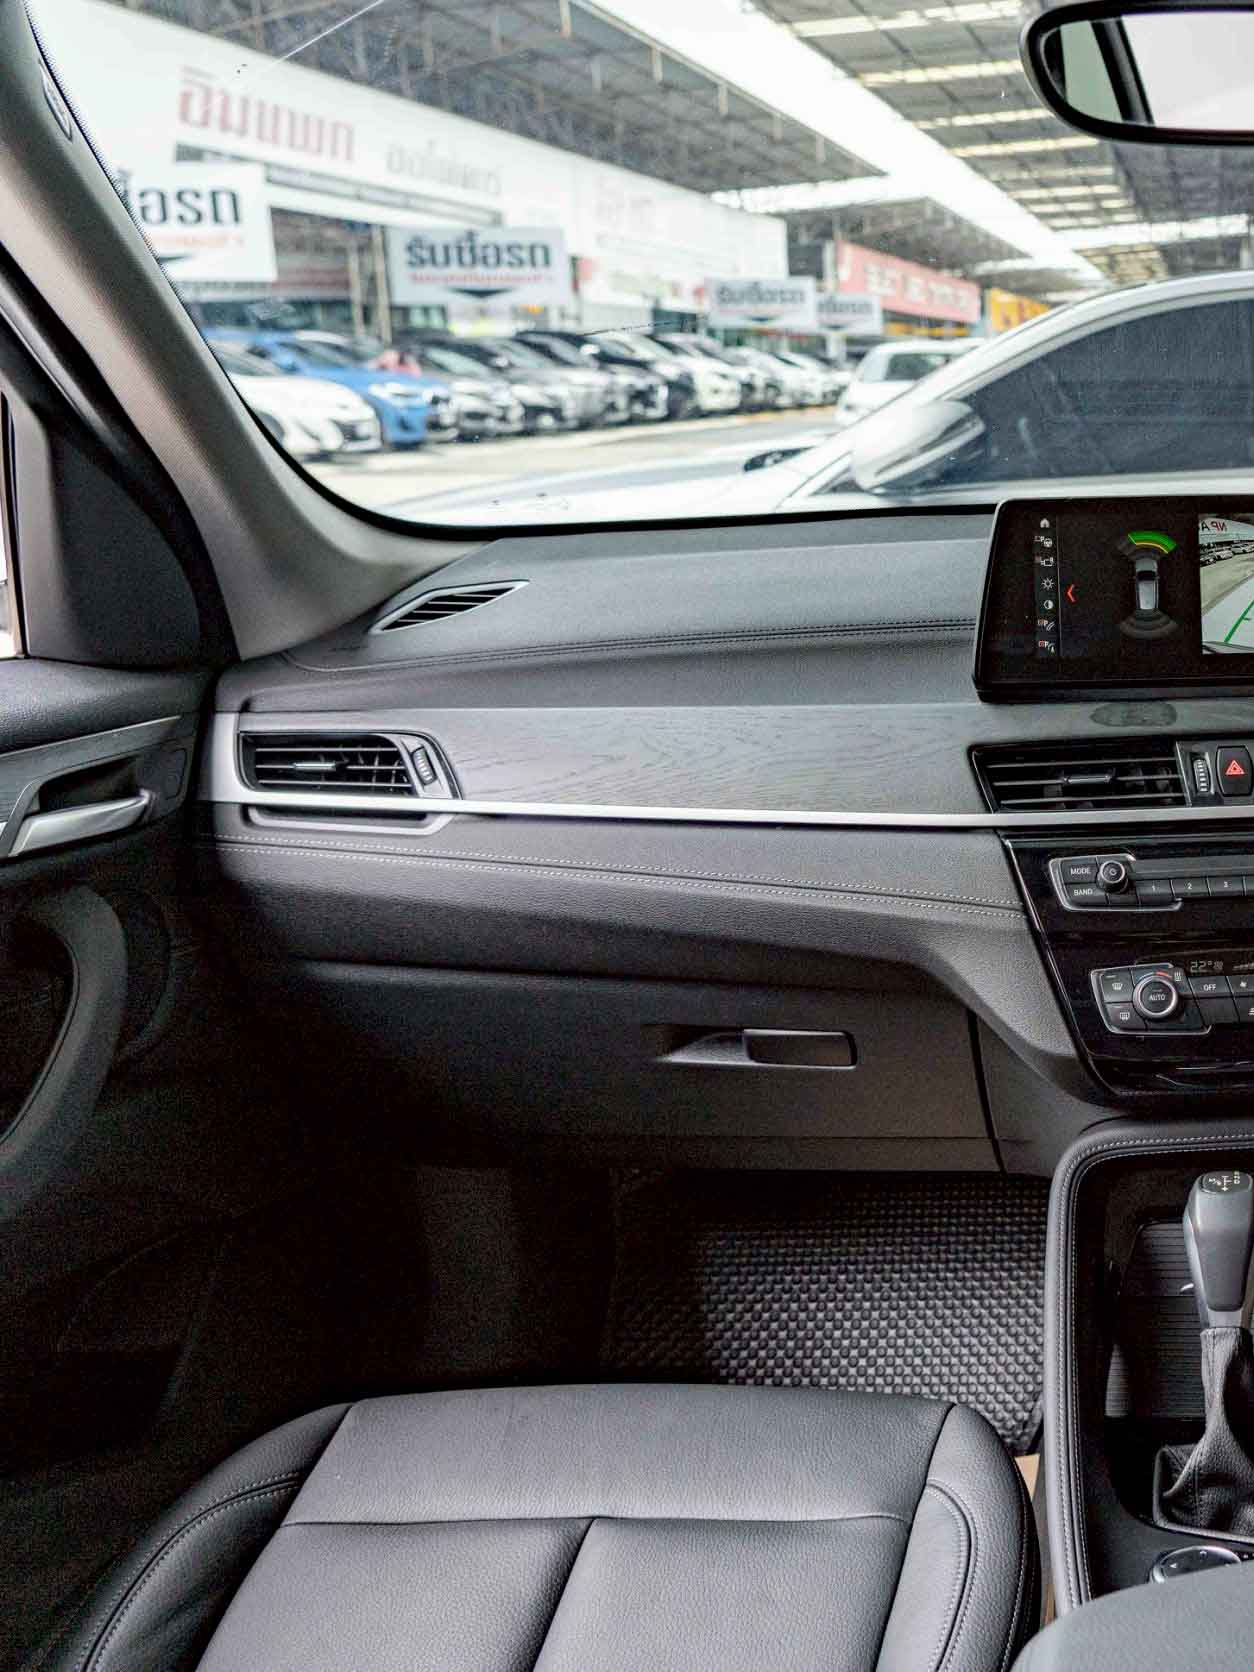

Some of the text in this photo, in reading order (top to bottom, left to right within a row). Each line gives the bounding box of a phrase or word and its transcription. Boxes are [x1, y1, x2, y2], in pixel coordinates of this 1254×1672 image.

[1070, 867, 1092, 875] MODE
[1073, 888, 1093, 896] BAND
[1203, 983, 1216, 992] OFF
[1150, 993, 1166, 1001] AUTO
